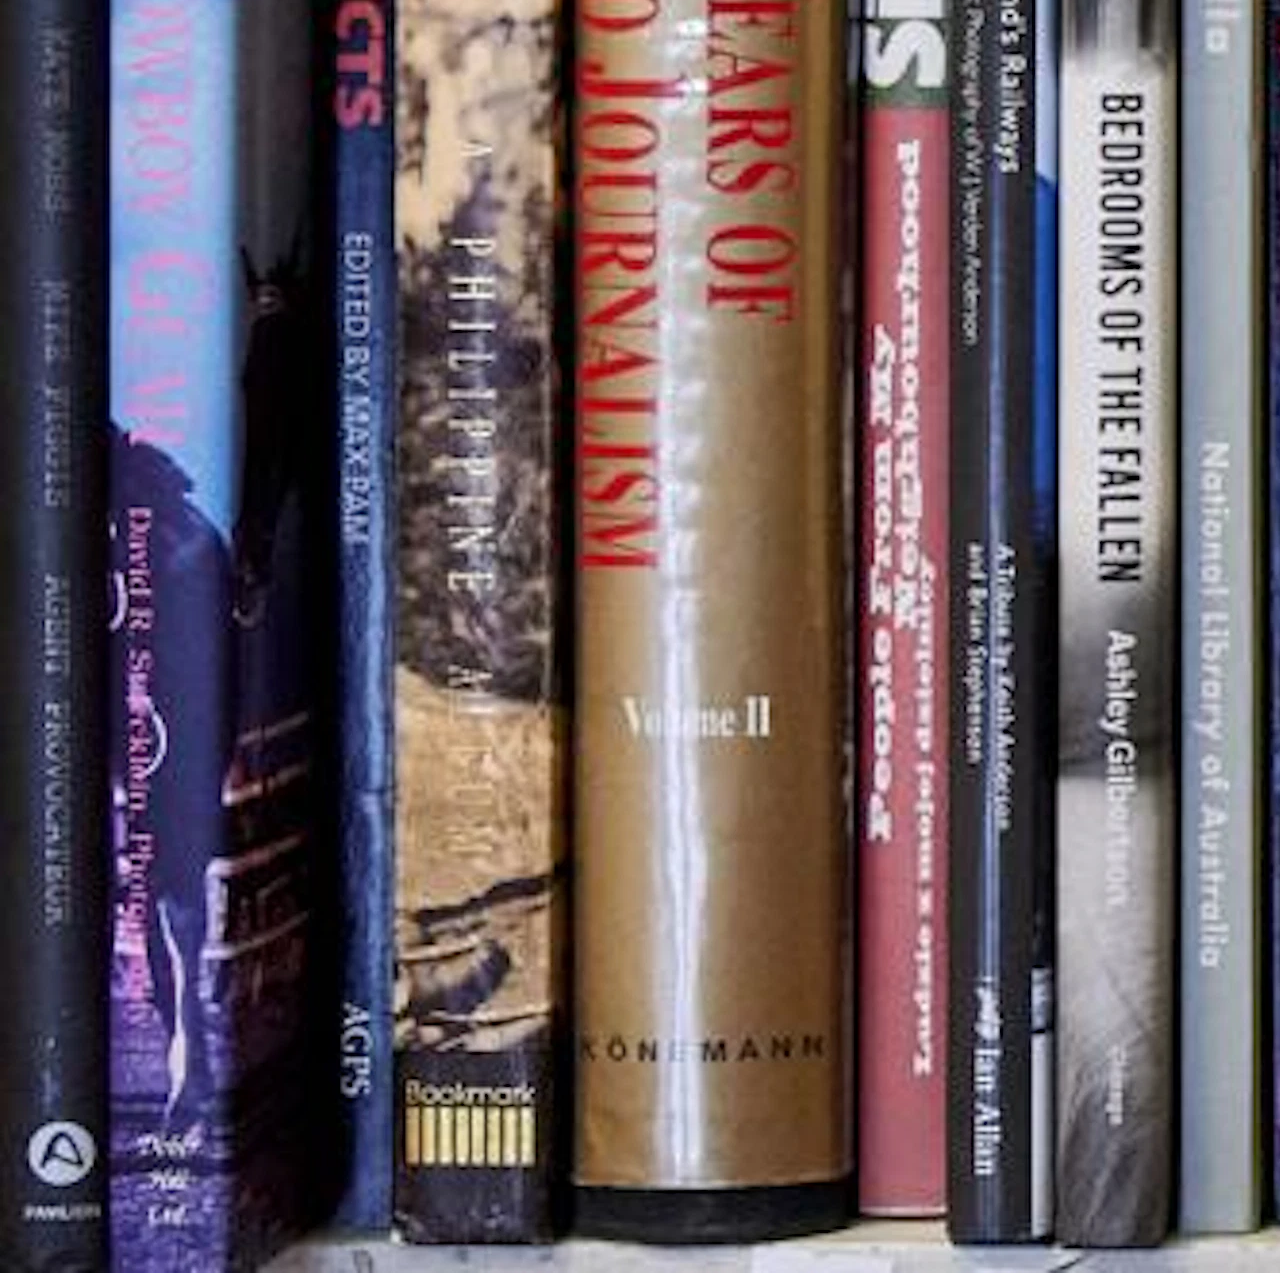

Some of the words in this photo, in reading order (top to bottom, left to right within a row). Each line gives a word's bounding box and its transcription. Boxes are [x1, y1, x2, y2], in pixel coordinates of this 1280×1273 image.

[43, 26, 71, 112] KATE
[958, 6, 985, 124] Photography
[993, 53, 1028, 174] Railways
[43, 129, 71, 215] MOSS
[1097, 93, 1144, 298] BEDROOMS
[43, 279, 71, 364] MIKE
[341, 231, 372, 337] EDITED
[576, 61, 688, 570] JOURNALISM
[706, 225, 799, 324] OF
[962, 254, 985, 348] Anderson
[341, 344, 372, 384] BY
[868, 323, 898, 425] My
[1097, 310, 1144, 352] OF
[341, 390, 372, 465] MAX
[445, 235, 501, 594] PHILIPPINE
[892, 138, 923, 629] Neighbourhood
[1097, 366, 1144, 432] THE
[44, 385, 72, 507] FIGGIS
[127, 506, 154, 595] David
[341, 472, 372, 544] PAM
[867, 439, 894, 613] From
[1096, 448, 1144, 583] FALLEN
[1199, 441, 1232, 597] National
[964, 543, 986, 580] and
[44, 573, 72, 676] AGENT
[963, 585, 986, 642] Brian
[961, 645, 986, 764] Stephenson
[1099, 628, 1135, 735] Ashley
[1190, 610, 1232, 740] Library
[867, 628, 897, 844] People
[1199, 753, 1232, 792] of
[44, 699, 72, 926] PROVOCATEUR
[1198, 803, 1232, 968] Australia
[338, 1001, 371, 1097] AGPS
[402, 1078, 536, 1102] Bookmark
[972, 1047, 1002, 1095] Ian
[972, 1102, 1002, 1177] Allan
